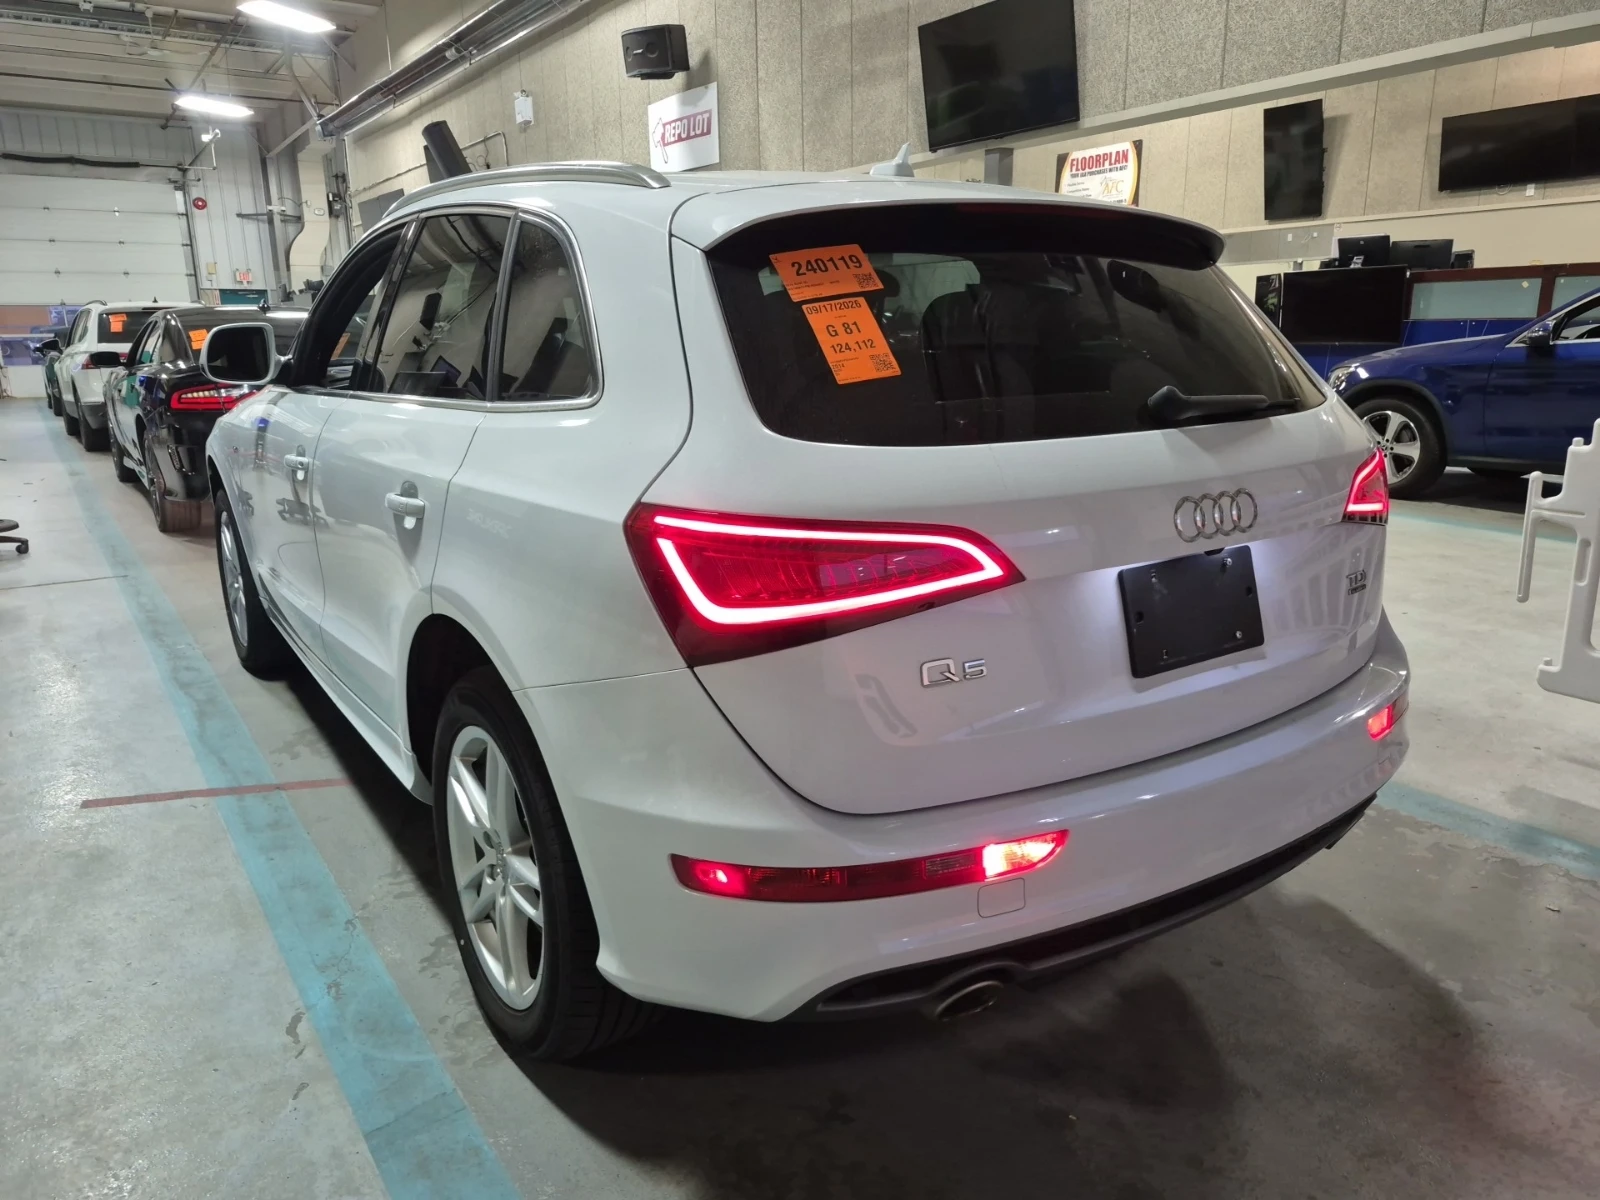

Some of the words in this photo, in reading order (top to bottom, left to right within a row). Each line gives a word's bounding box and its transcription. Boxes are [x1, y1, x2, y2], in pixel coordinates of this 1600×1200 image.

[664, 119, 688, 144] REPO
[690, 113, 710, 137] LOT
[1069, 149, 1129, 173] FLOORPLAN
[1087, 168, 1108, 177] PURCHASES
[1102, 179, 1124, 195] AFC
[791, 254, 863, 277] 240119
[239, 272, 250, 281] EXIT
[805, 300, 862, 315] 09/17/2026
[825, 324, 839, 338] G
[844, 321, 862, 335] 81
[830, 338, 876, 354] 124,112
[920, 657, 988, 688] Q5
